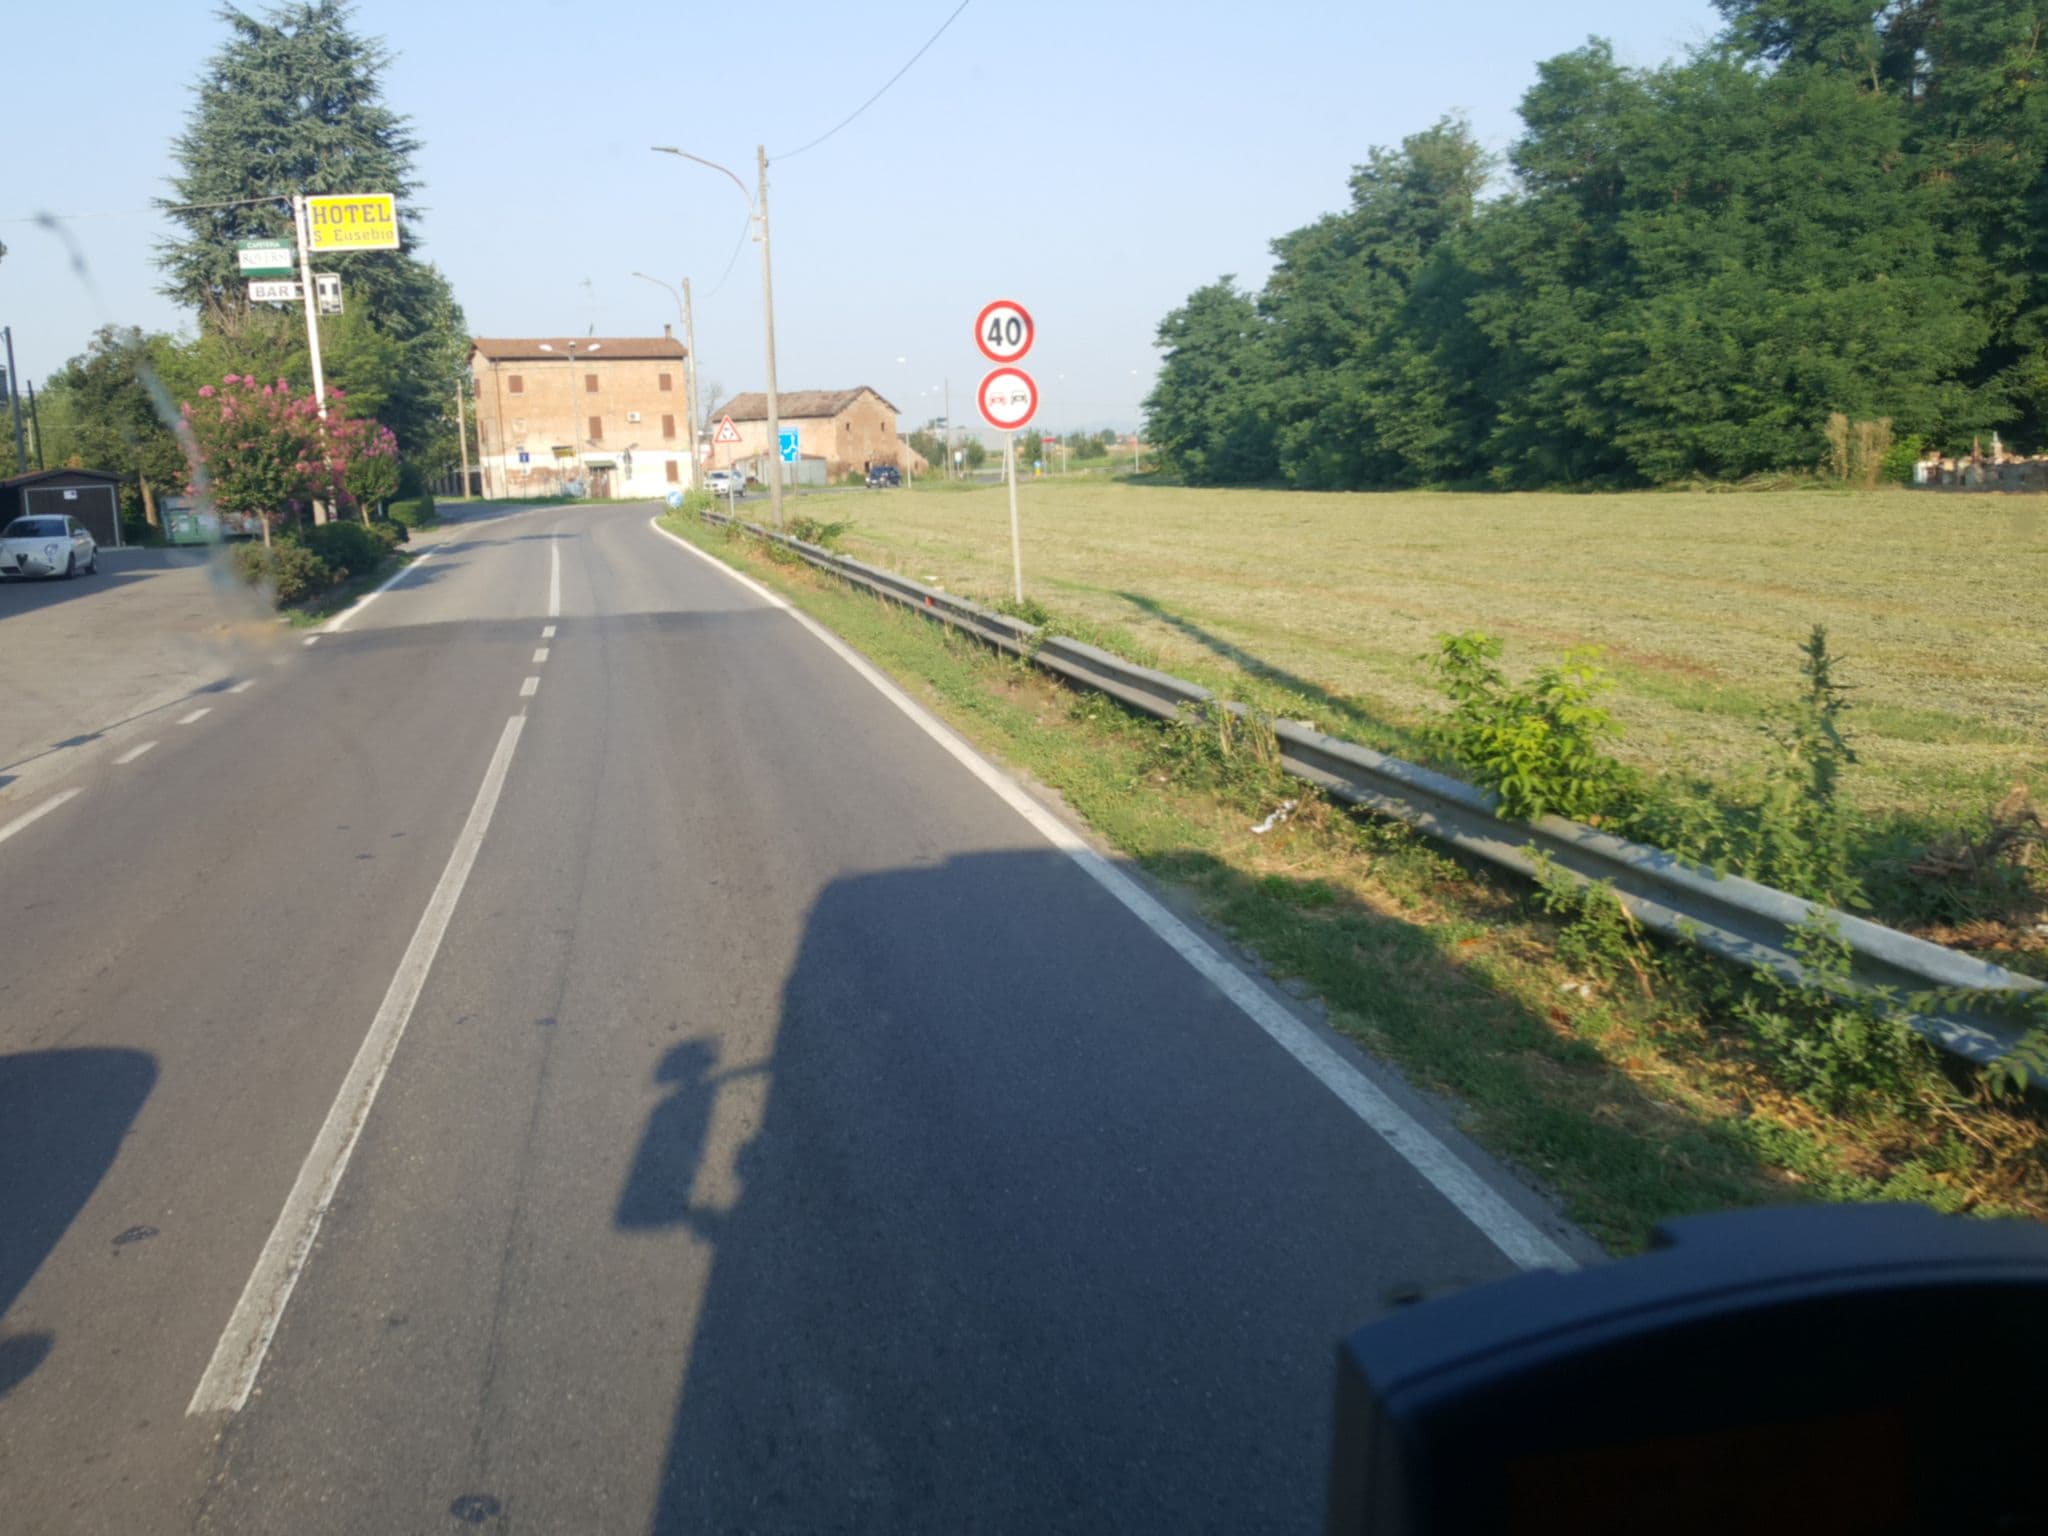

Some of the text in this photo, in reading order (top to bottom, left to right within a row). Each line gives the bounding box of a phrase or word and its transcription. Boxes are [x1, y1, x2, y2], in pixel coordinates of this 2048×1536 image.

[311, 203, 391, 225] HOTEL
[333, 227, 394, 242] Eusebio
[255, 285, 290, 298] BAR
[987, 316, 1022, 347] 40
